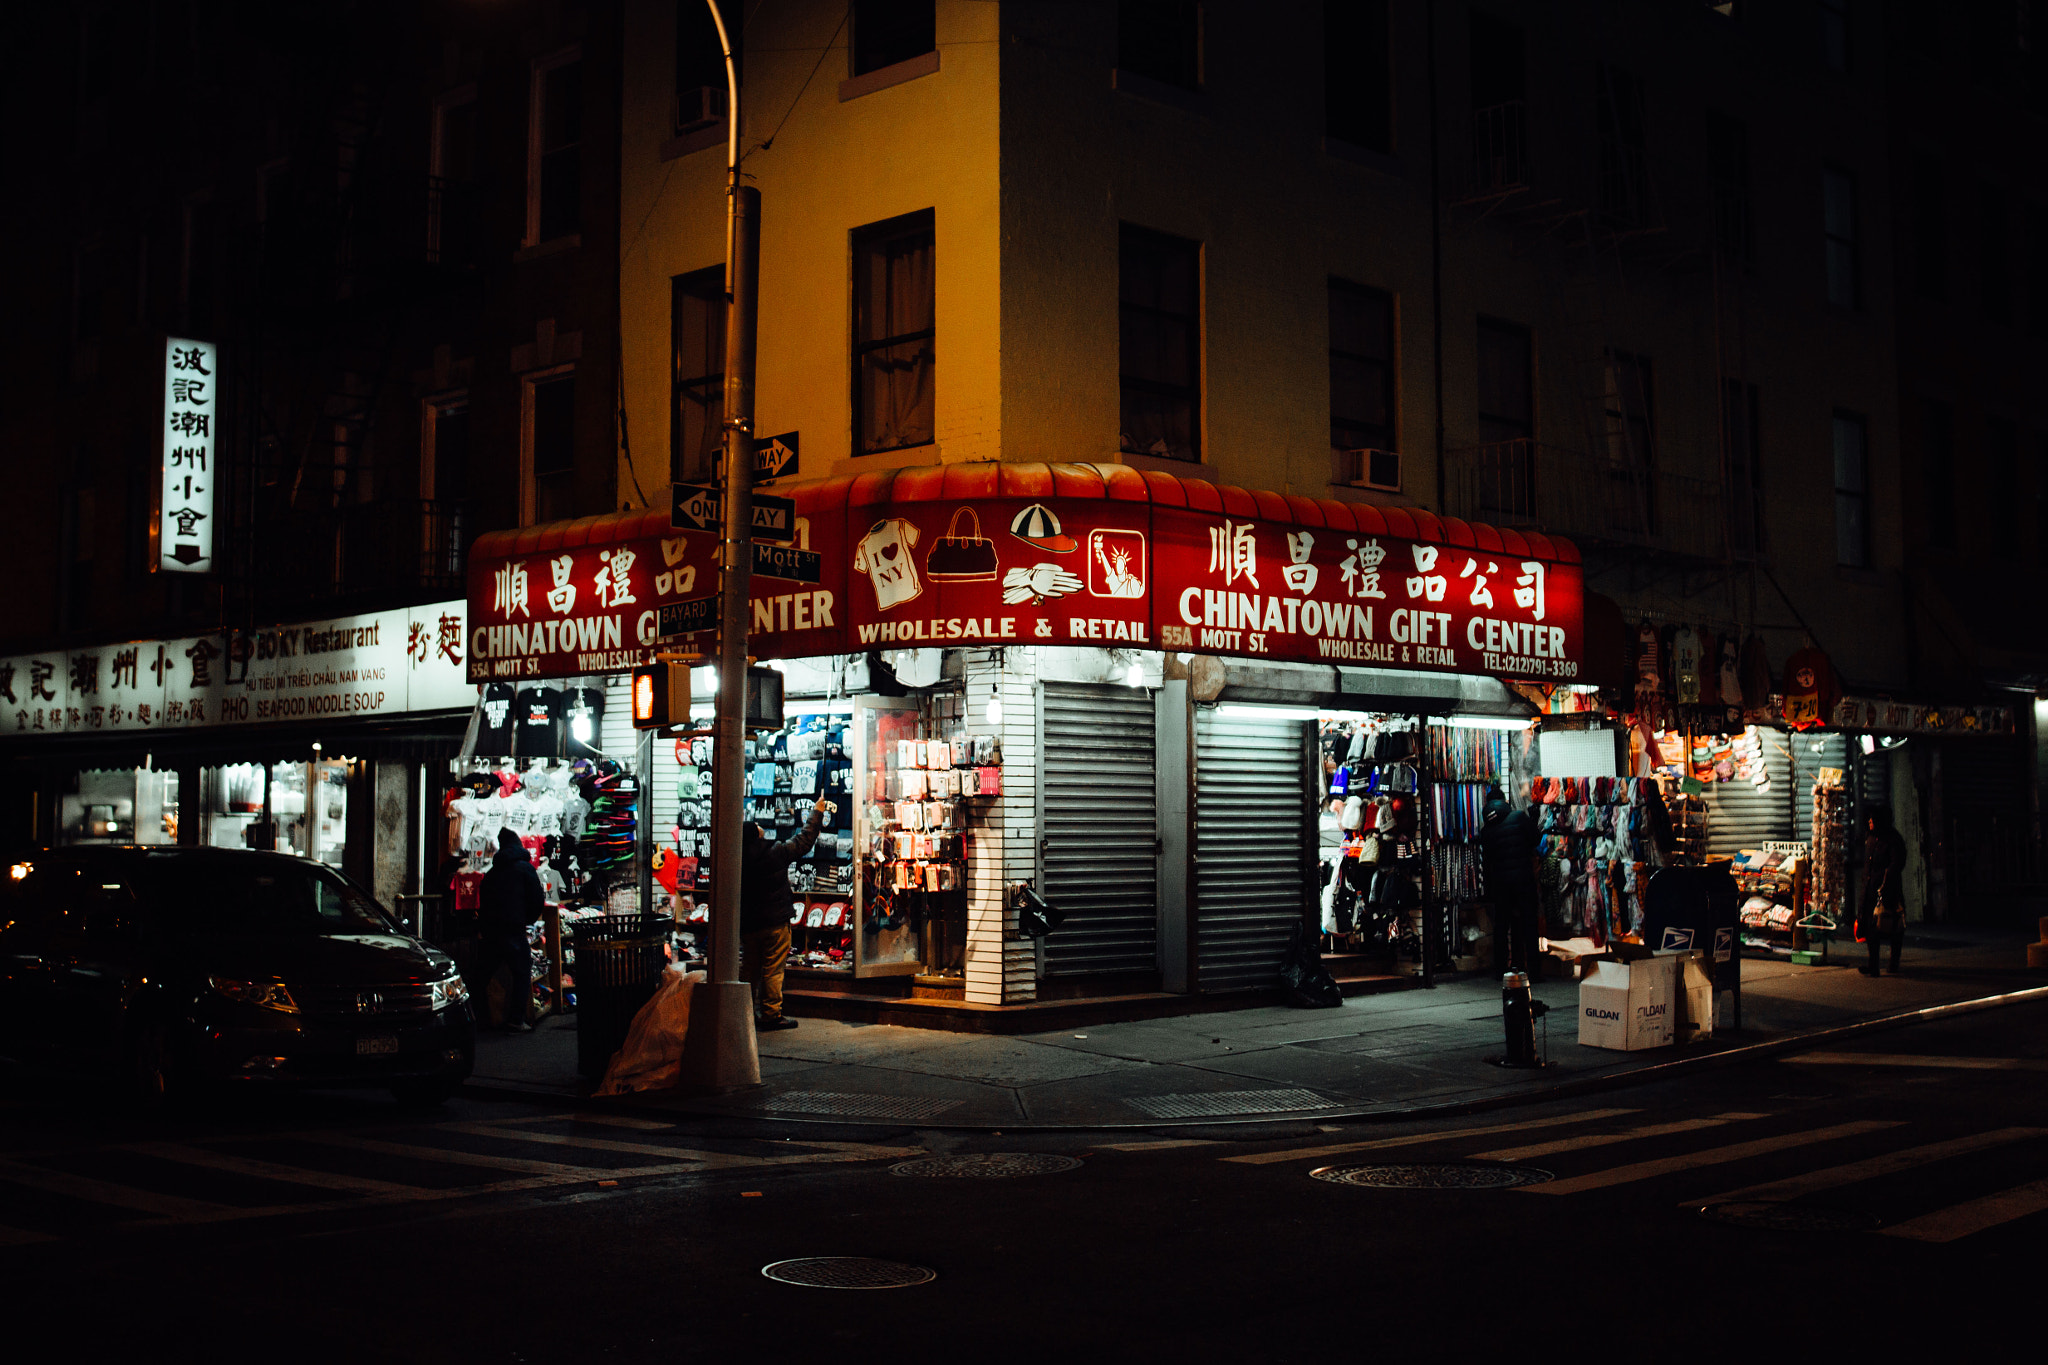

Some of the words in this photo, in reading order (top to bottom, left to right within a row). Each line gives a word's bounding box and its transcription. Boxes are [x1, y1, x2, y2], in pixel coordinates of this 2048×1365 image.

[757, 447, 785, 469] WAY
[751, 508, 778, 526] AY
[759, 546, 800, 568] Mott
[806, 553, 815, 563] St
[877, 562, 906, 588] NY
[1208, 518, 1546, 621] 順昌禮品公司
[663, 602, 707, 623] BAYARD
[1179, 586, 1374, 640] CHINATOWN
[1389, 608, 1452, 647] GIFT
[1467, 616, 1566, 659] CENTER
[472, 614, 622, 659] CHINATOWN
[748, 590, 835, 635] NTER
[858, 617, 1017, 644] WHOLESALE
[1034, 618, 1053, 638] &
[1069, 617, 1150, 643] RETAIL
[257, 632, 278, 661] BO
[279, 629, 302, 658] KY
[303, 619, 380, 655] Restaurant
[1162, 625, 1194, 646] 55A
[1200, 627, 1241, 650] MOTT
[1249, 630, 1269, 653] ST.
[578, 649, 643, 671] WHOLESALE
[1318, 638, 1394, 662] WHOLESALE
[1401, 645, 1410, 662] &
[1417, 646, 1457, 667] RETAIL
[339, 670, 358, 684] NAM
[361, 667, 385, 681] VANG
[471, 661, 489, 678] 55A
[494, 659, 522, 676] MOTT
[526, 658, 541, 675] ST.
[1482, 652, 1578, 677] TEL:(212)791-3369
[257, 697, 306, 718] SEAFOOD
[308, 694, 350, 715] NOODLE
[354, 691, 385, 711] SOUP
[1887, 706, 1908, 726] MOTT
[793, 766, 816, 778] NYPD
[1585, 1007, 1620, 1021] GILDAN
